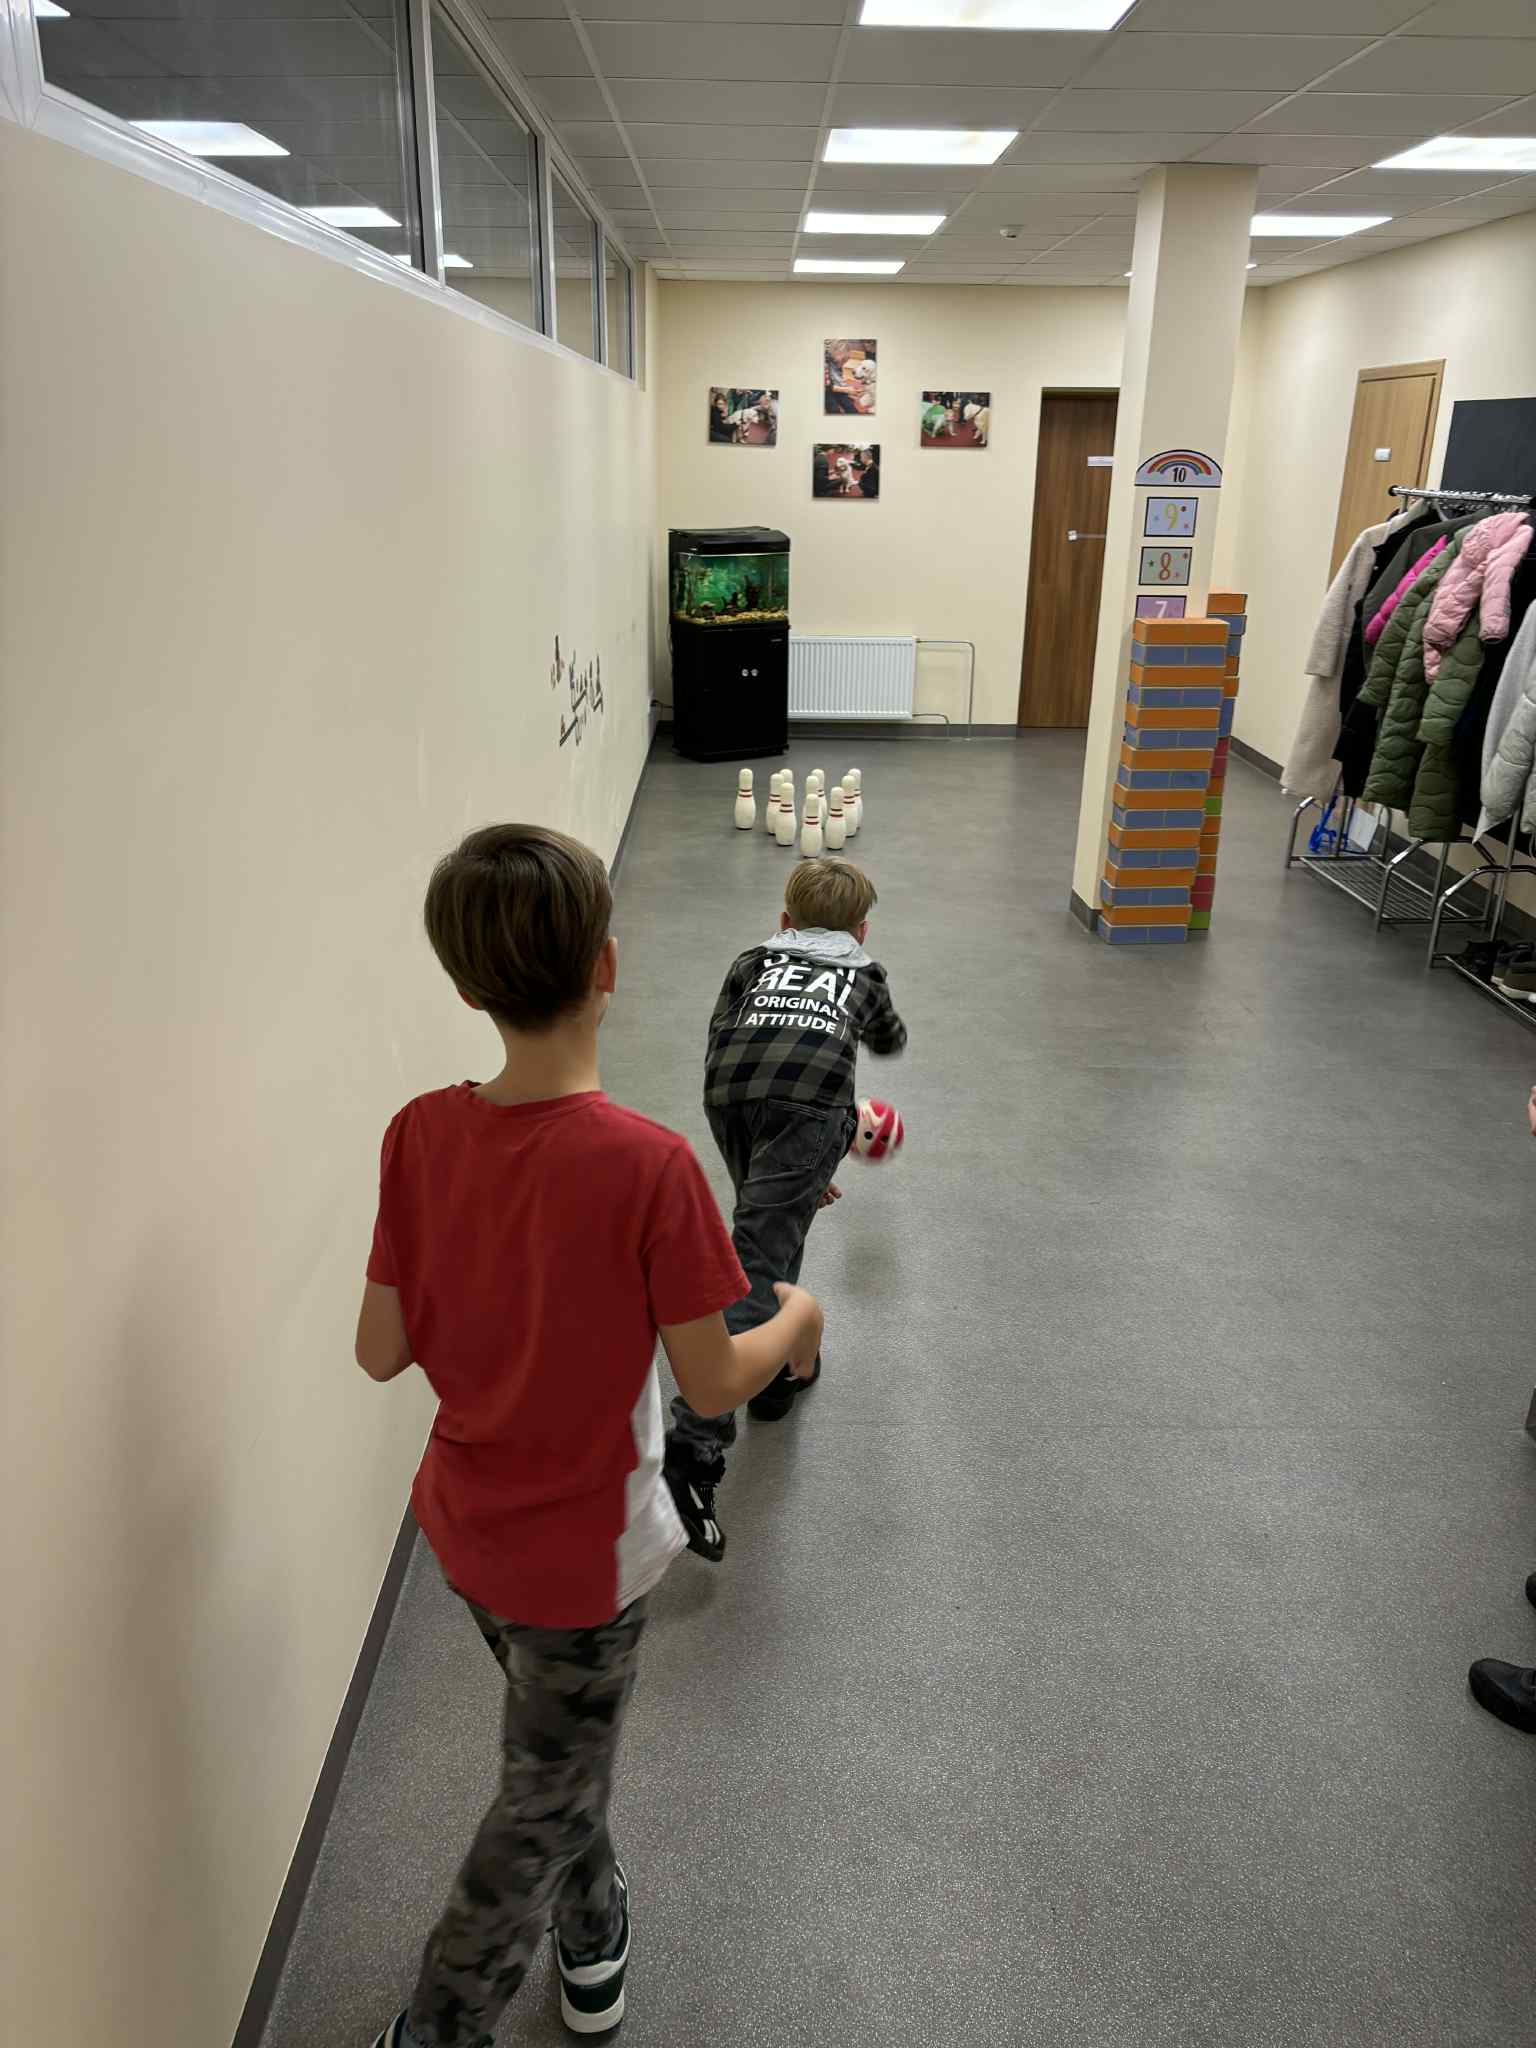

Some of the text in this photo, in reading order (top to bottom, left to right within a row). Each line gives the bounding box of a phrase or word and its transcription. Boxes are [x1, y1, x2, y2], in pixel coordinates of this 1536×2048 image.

[1172, 467, 1187, 483] 10
[1164, 503, 1178, 529] 9
[1159, 552, 1172, 580] 8
[1155, 600, 1168, 618] 7
[754, 995, 840, 1020] ORIGINAL
[745, 1013, 837, 1034] ATTITUDE
